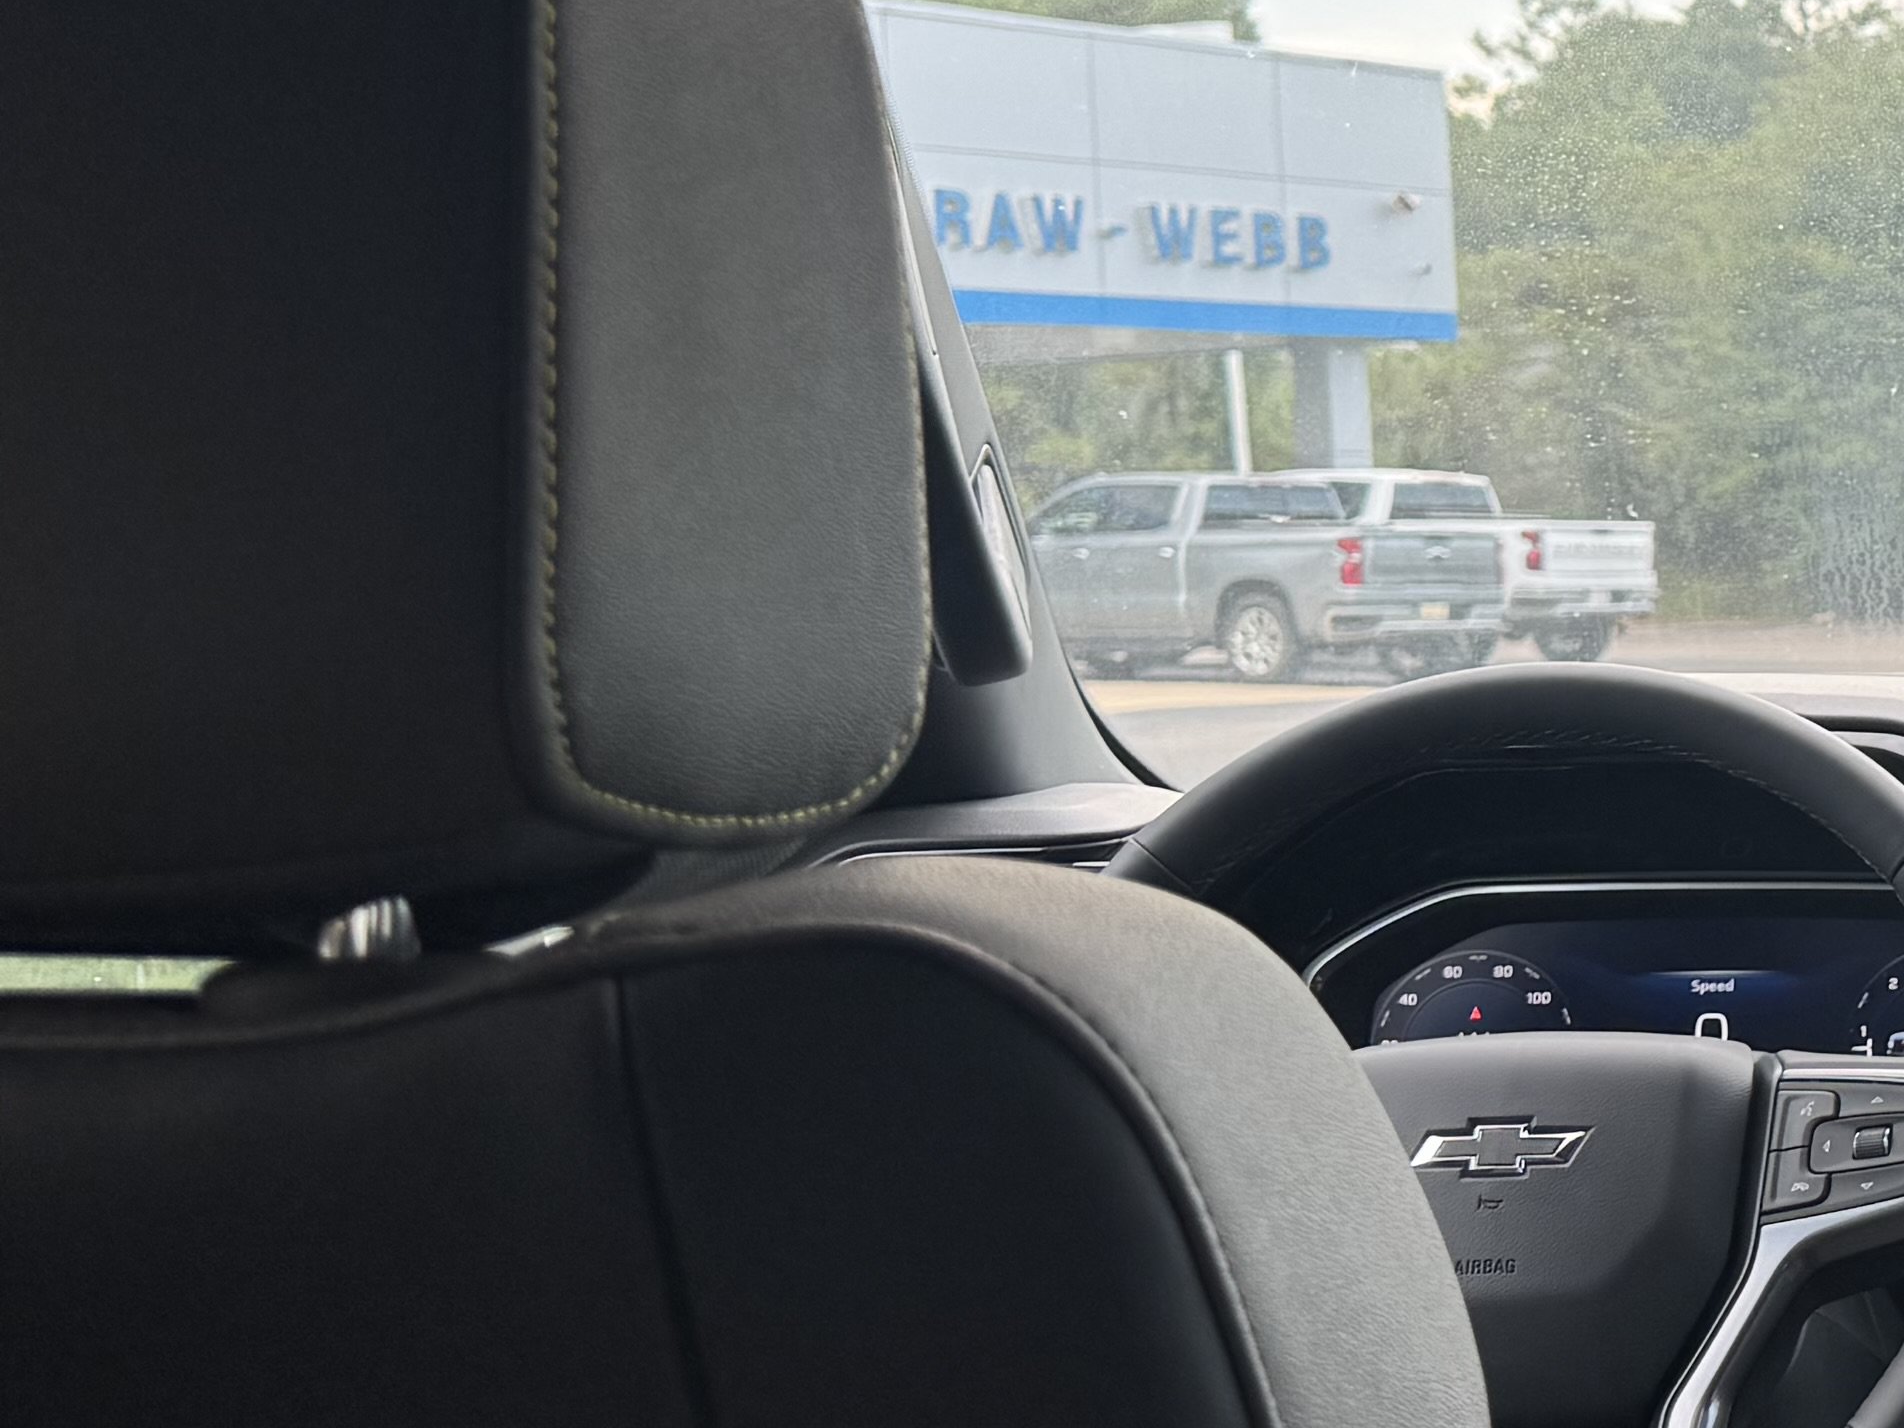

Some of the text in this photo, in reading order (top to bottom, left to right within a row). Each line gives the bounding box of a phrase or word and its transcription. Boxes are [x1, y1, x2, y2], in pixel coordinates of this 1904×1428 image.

[1443, 966, 1462, 978] 60
[1493, 966, 1514, 978] 80
[1691, 978, 1735, 996] Speed
[1398, 993, 1418, 1006] 40
[1526, 992, 1552, 1006] 100
[1455, 1258, 1516, 1276] AIRBAG
